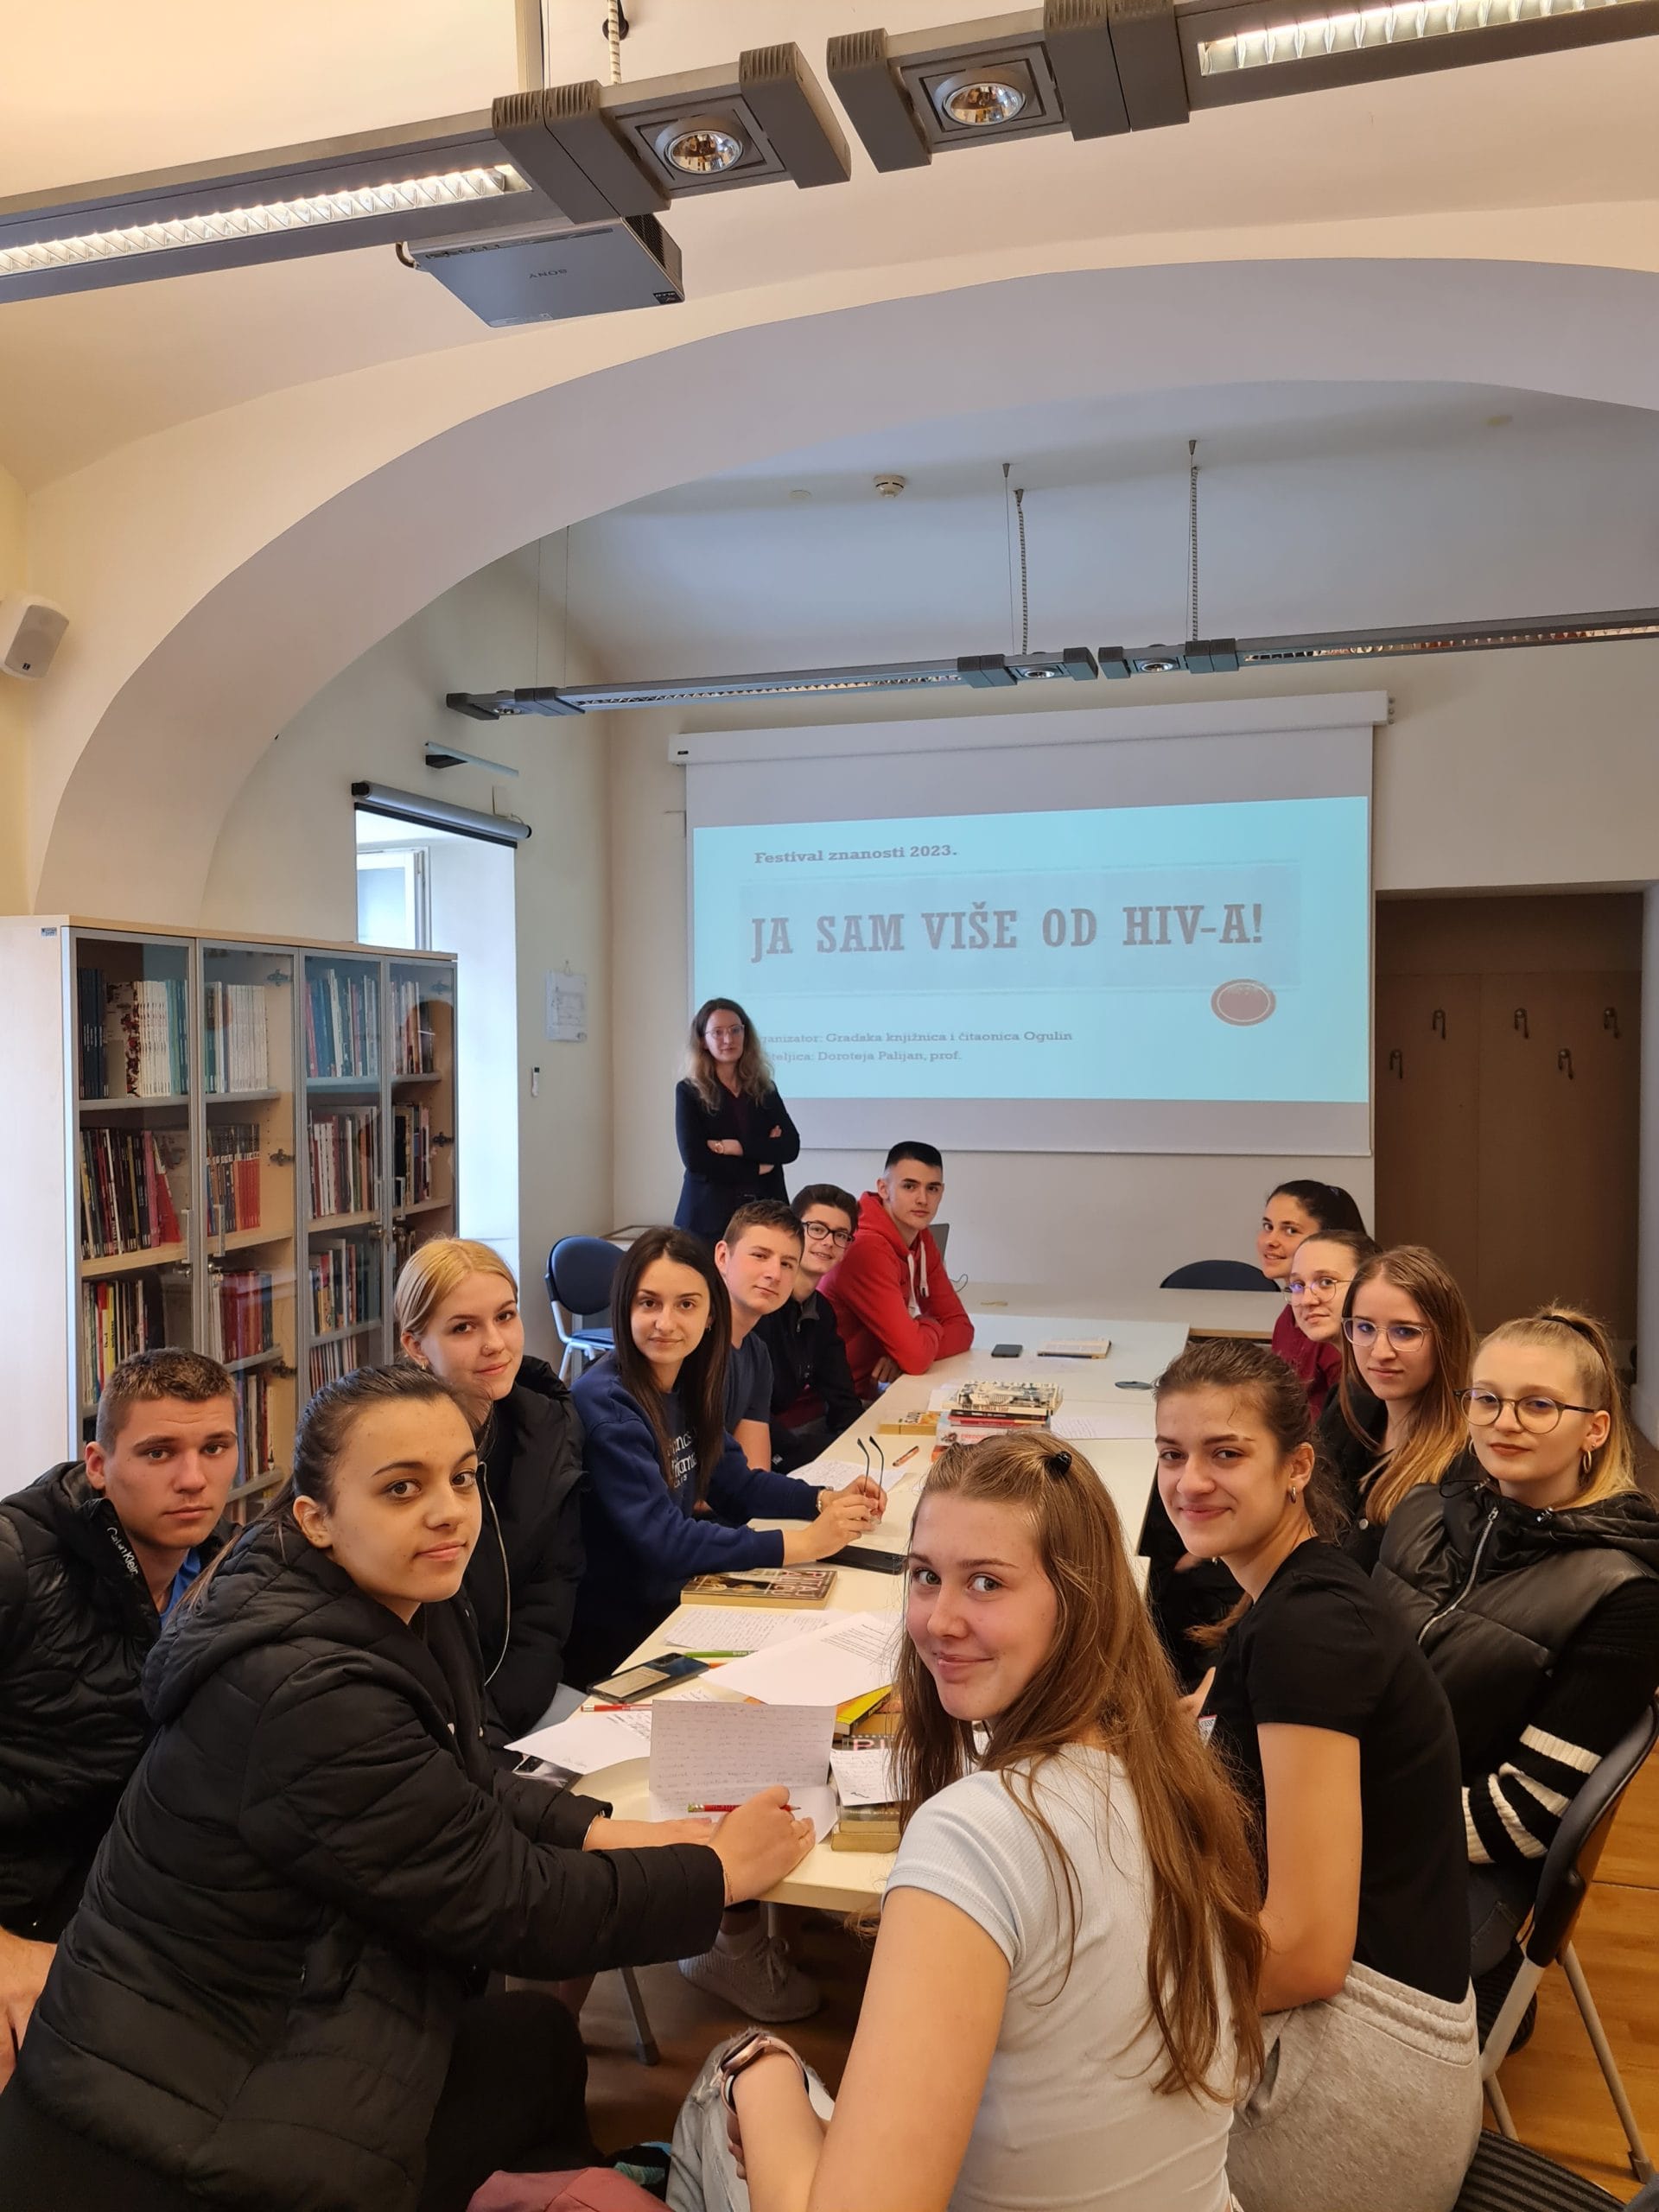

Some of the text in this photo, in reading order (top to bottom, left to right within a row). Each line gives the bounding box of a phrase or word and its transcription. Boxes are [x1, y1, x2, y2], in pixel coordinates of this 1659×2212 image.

[528, 269, 568, 279] SONY
[754, 844, 957, 864] Festival znanosti 2023.
[750, 901, 1262, 964] JA SAM VIŠE OD HIV-A!
[761, 1034, 823, 1045] ganizator:
[825, 1033, 883, 1043] Gradska
[886, 1032, 948, 1045] knjižnica
[1023, 1031, 1072, 1044] Ogulin
[817, 1052, 875, 1064] Doroteja
[930, 1051, 962, 1063] prof.
